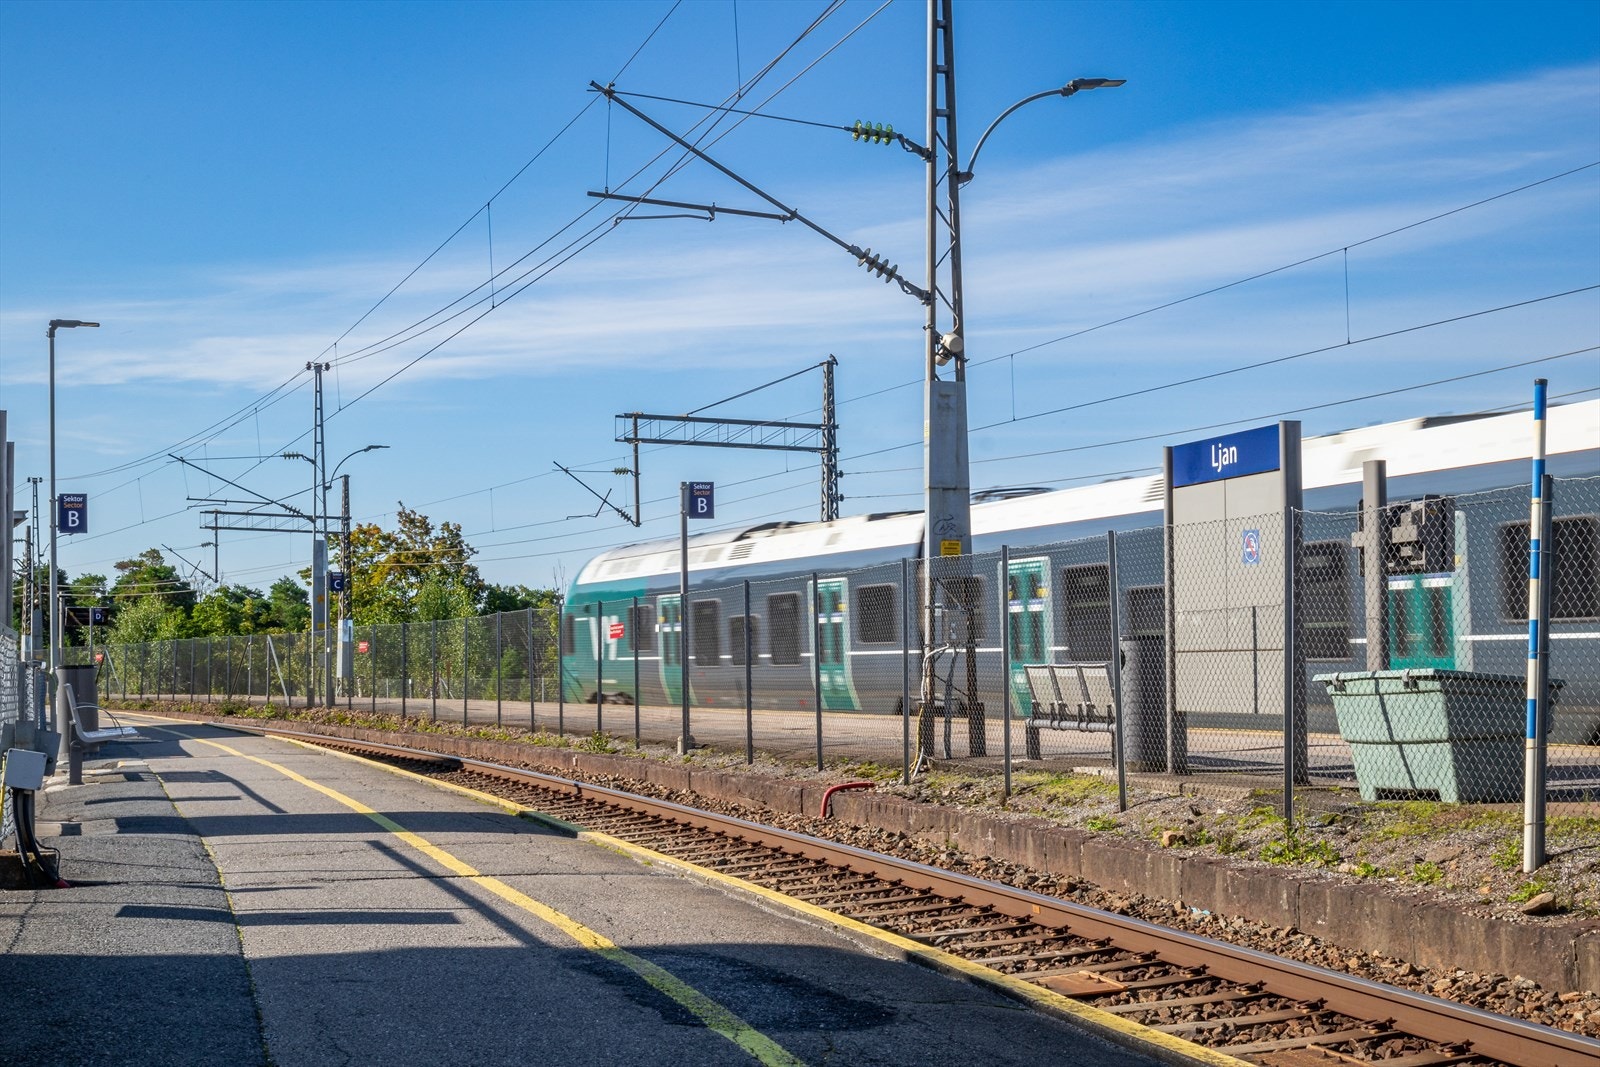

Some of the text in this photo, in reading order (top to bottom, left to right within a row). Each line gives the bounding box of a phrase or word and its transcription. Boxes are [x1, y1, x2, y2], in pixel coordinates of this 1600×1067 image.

[1211, 443, 1237, 472] Ljan
[697, 497, 708, 513] B
[68, 510, 80, 527] B
[334, 580, 341, 589] C
